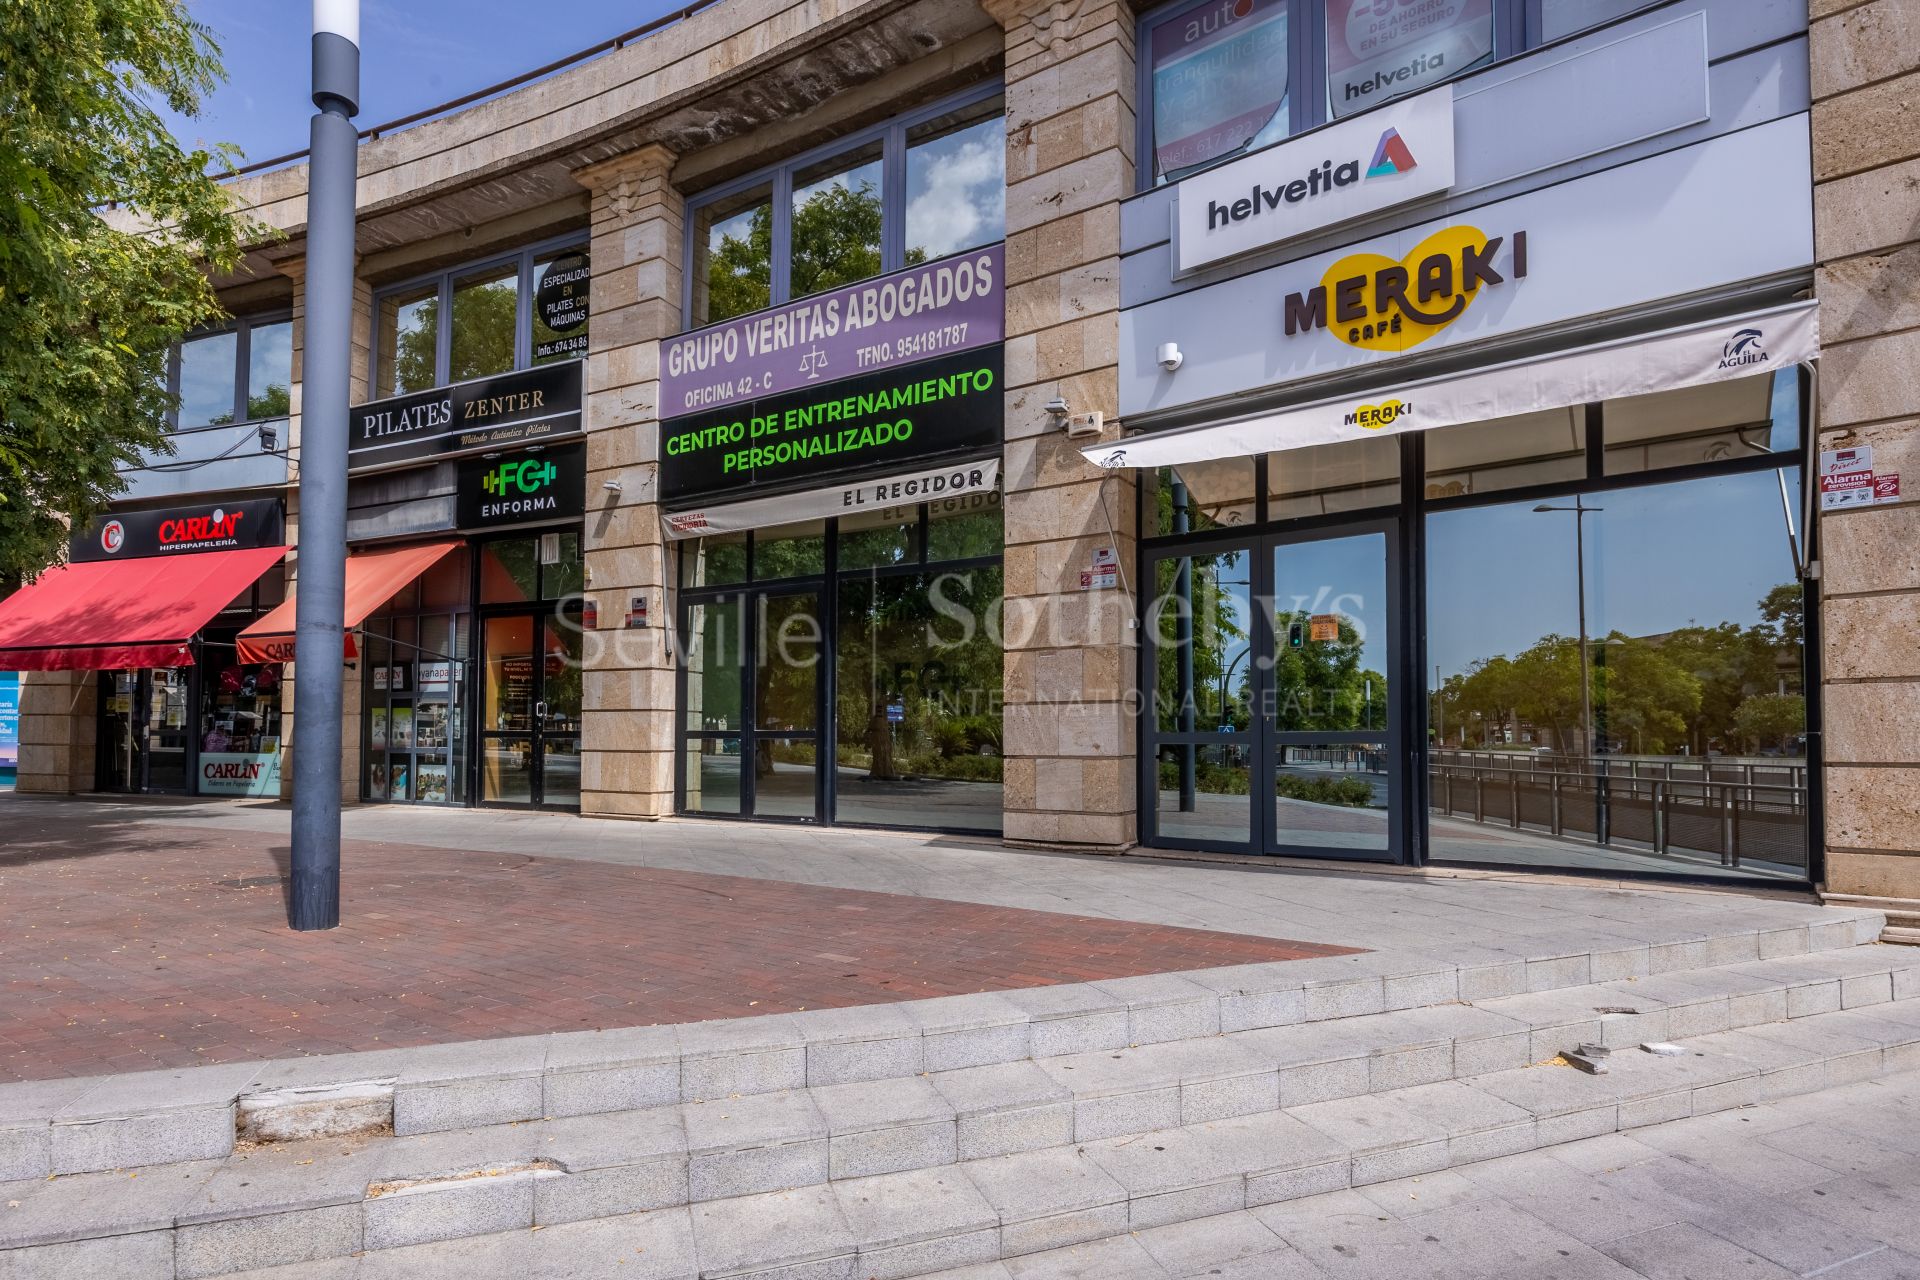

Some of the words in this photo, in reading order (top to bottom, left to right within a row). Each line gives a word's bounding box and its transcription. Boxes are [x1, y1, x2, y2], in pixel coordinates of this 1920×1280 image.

[1360, 38, 1377, 51] EN
[1381, 30, 1398, 44] SU
[1401, 6, 1455, 33] SEGURO
[1369, 21, 1386, 34] DE
[1390, 0, 1444, 26] AHORRO
[1345, 52, 1444, 100] helvetia
[1208, 159, 1359, 230] helvetia
[556, 256, 582, 270] CENTRO
[563, 285, 573, 297] EN
[1284, 230, 1528, 336] MERAKI
[547, 298, 574, 314] PILATES
[550, 310, 586, 327] MÁQUINAS
[668, 328, 738, 378] GRUPO
[745, 299, 840, 357] VERITAS
[845, 255, 993, 333] ABOGADOS
[856, 342, 894, 368] TFNO.
[897, 322, 969, 359] 954181787
[1349, 314, 1402, 343] CAFÉ
[685, 381, 734, 408] OFICINA
[737, 376, 752, 396] 42
[763, 371, 773, 390] C
[363, 399, 451, 439] PILATES
[464, 390, 545, 419] ZENTER
[666, 422, 745, 456] CENTRO
[751, 413, 779, 438] DE
[784, 368, 994, 431] ENTRENAMIENTO
[1344, 402, 1412, 425] MERAKI
[461, 432, 488, 445] Método
[525, 424, 551, 436] Pilates
[723, 418, 913, 473] PERSONALIZADO
[843, 490, 865, 507] EL
[876, 469, 984, 502] REGIDOR
[1824, 473, 1871, 485] Alarma
[481, 497, 556, 517] ENFORMA
[160, 538, 238, 551] HIPERPAPELERÍA
